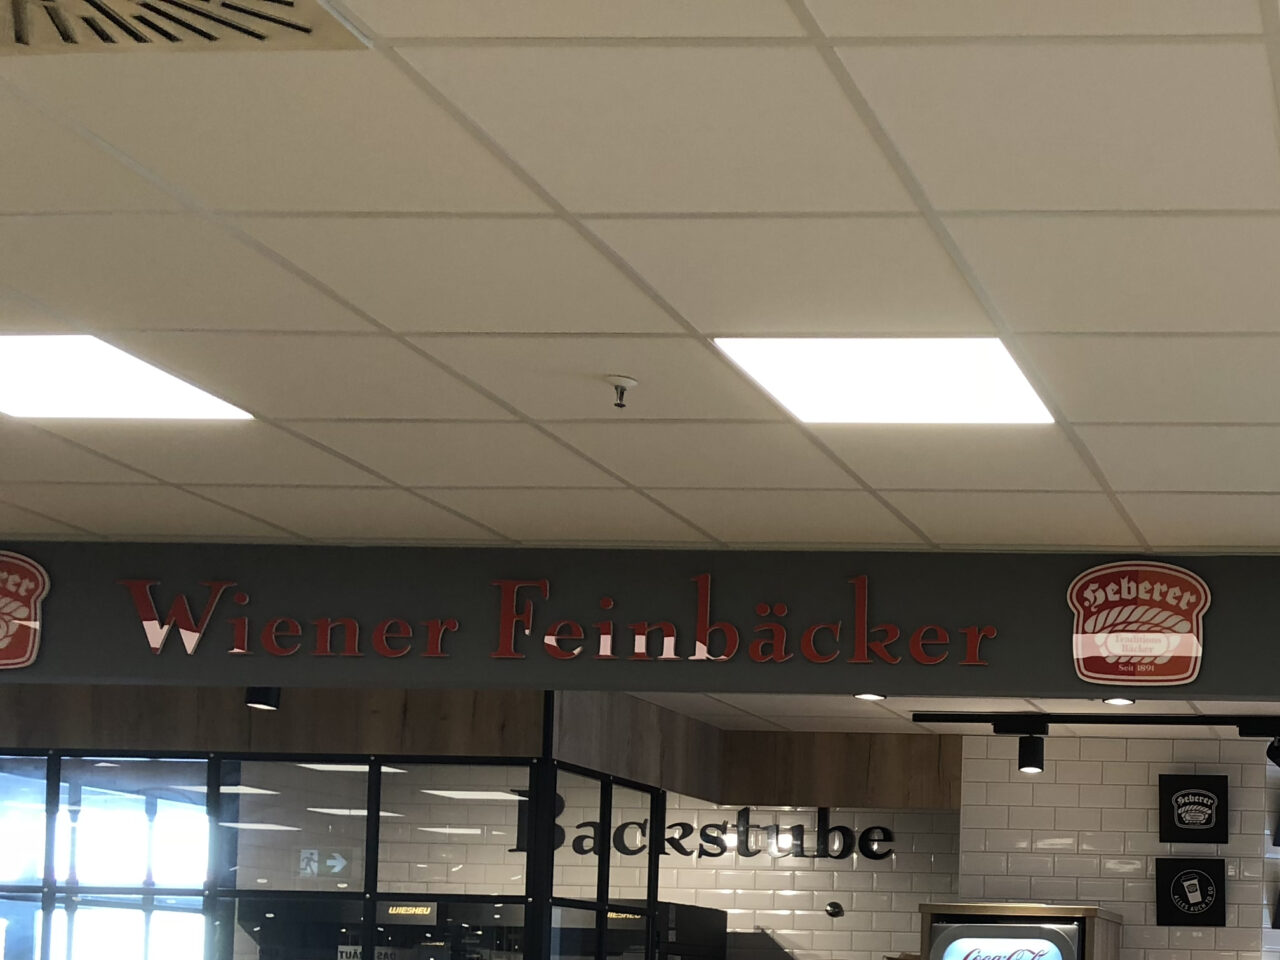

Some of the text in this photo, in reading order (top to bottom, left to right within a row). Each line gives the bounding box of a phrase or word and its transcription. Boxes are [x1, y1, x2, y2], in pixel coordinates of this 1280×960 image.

[1083, 575, 1197, 612] Heberer
[117, 573, 997, 667] Wiener Feinbäcker
[1118, 664, 1155, 672] Seit 1891
[388, 906, 431, 915] WIESHEU
